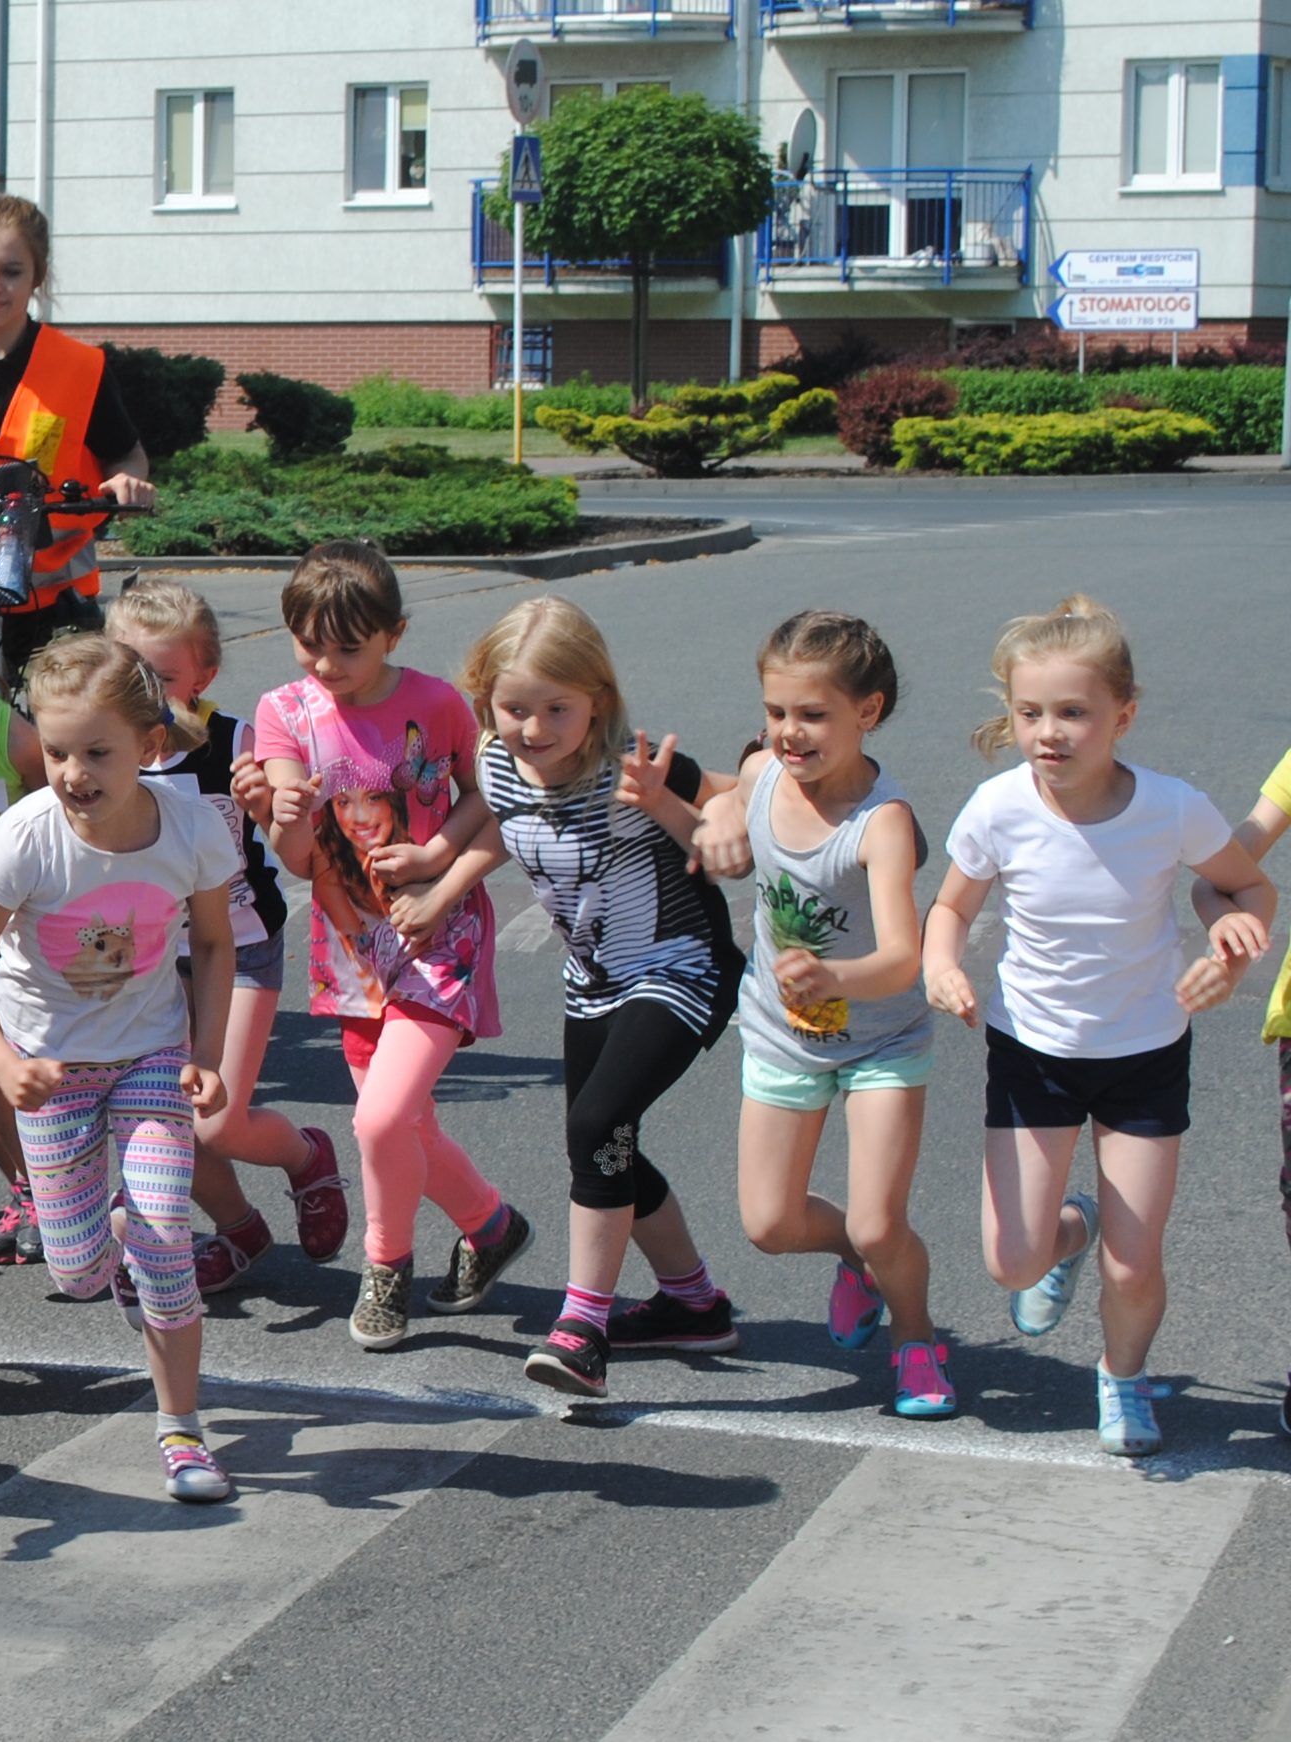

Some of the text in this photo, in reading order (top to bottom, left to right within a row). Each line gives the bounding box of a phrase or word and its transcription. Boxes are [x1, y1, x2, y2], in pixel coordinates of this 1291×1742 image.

[1088, 252, 1194, 263] CENTRUM MEDYCZNE
[1078, 296, 1191, 313] STOMATOLOG
[756, 882, 851, 934] ROPICAL
